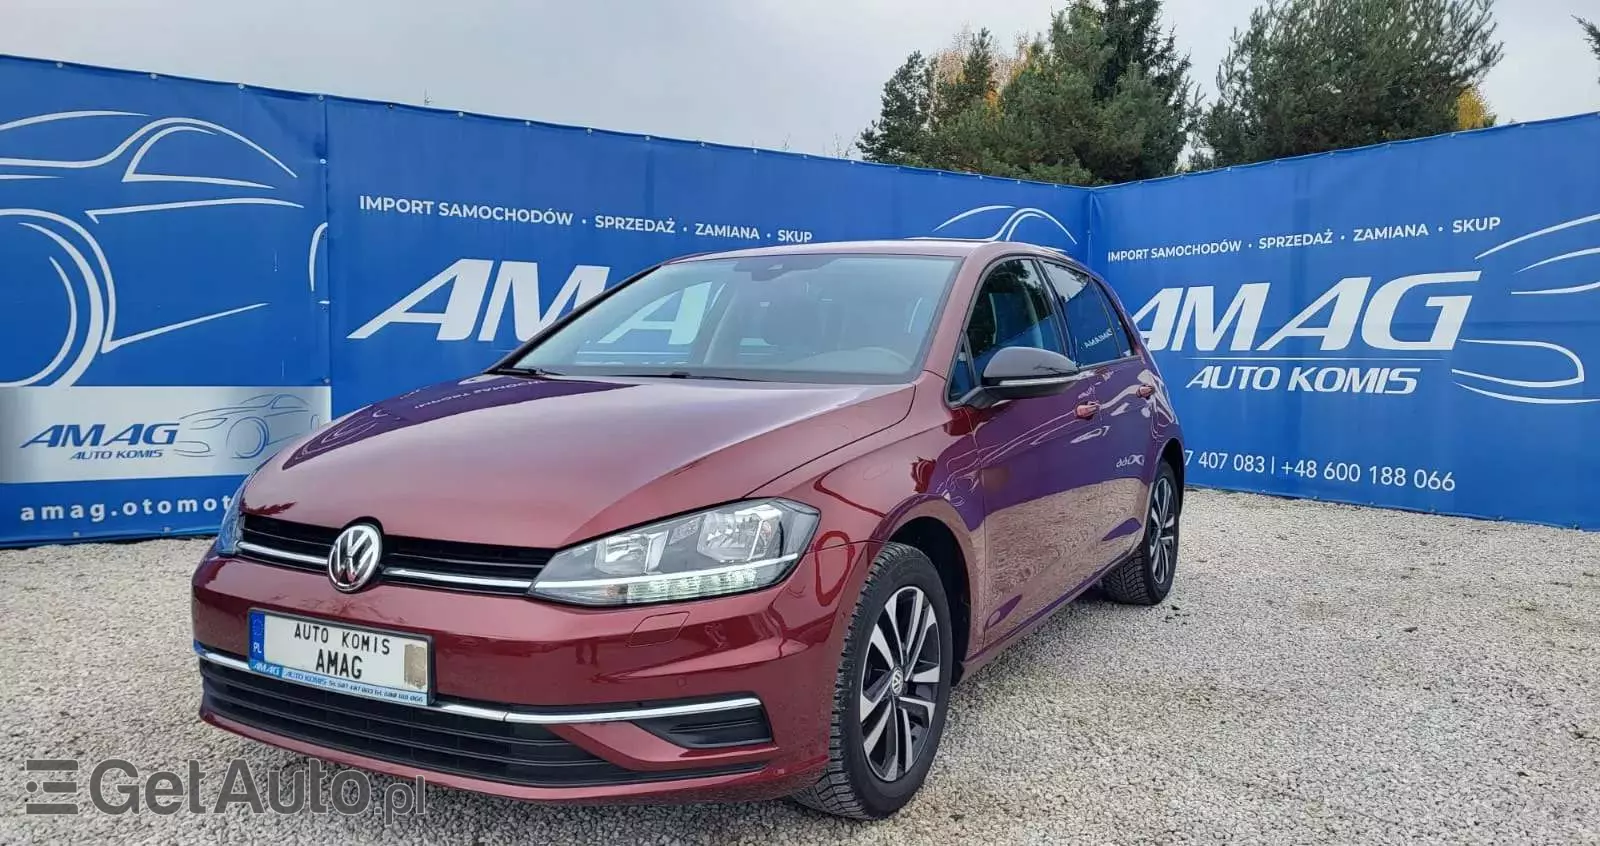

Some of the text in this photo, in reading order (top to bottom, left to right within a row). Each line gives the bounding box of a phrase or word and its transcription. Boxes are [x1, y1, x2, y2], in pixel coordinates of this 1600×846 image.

[359, 195, 813, 244] IMPORT SAMOCHODÓW SPRZEDAŻ ZAMIANA SKUP
[1107, 216, 1502, 263] IMPORT SAMOCHODÓW SPRZEDAŻ ZAMIANA SKUP
[1131, 270, 1483, 352] AMAG
[1185, 365, 1422, 396] AUTO KOMIS
[20, 423, 181, 449] AMAG
[70, 450, 164, 461] AUTO KOMIS
[1198, 451, 1229, 470] 407
[1233, 454, 1265, 474] 083
[1281, 459, 1318, 479] +48
[1323, 462, 1361, 483] 600
[1369, 465, 1407, 487] 188
[1413, 469, 1456, 492] 066
[253, 643, 263, 654] PL
[294, 622, 391, 656] AUTO KOMIS
[315, 648, 363, 680] AMAG
